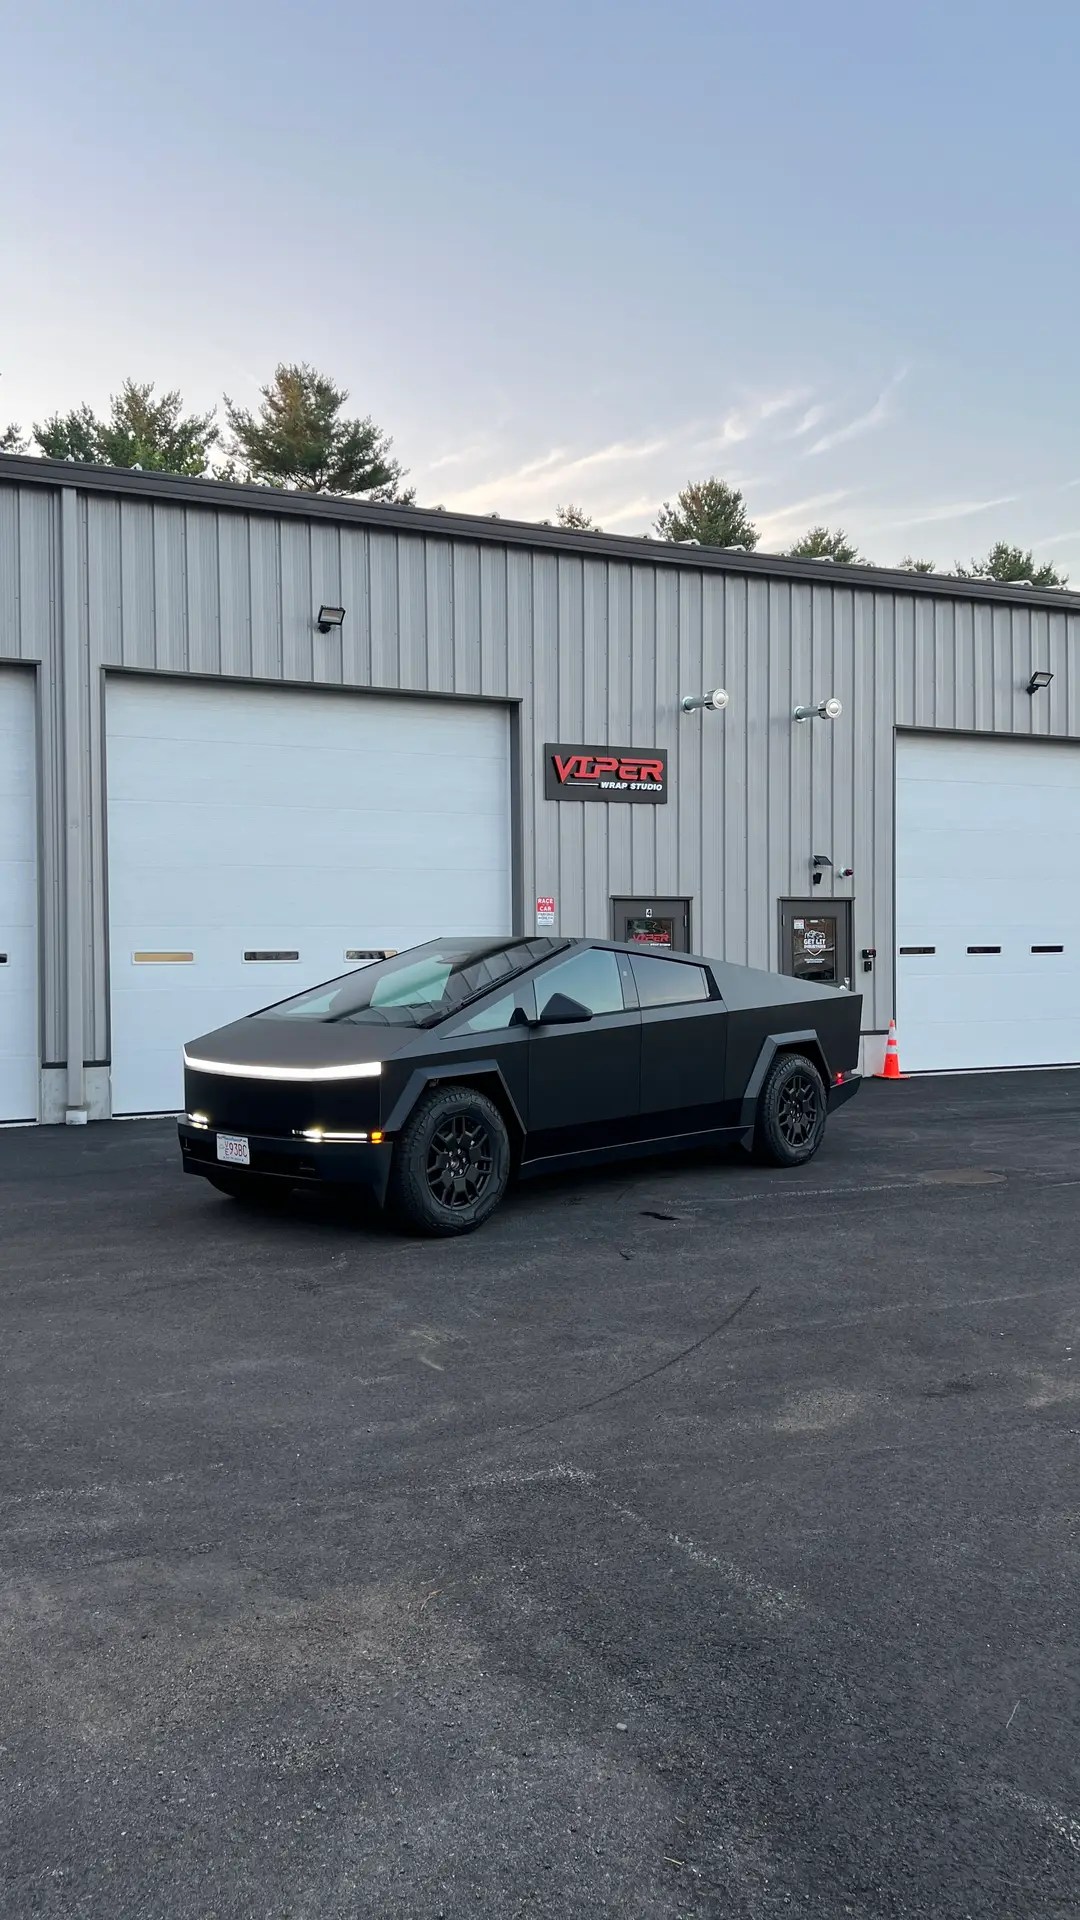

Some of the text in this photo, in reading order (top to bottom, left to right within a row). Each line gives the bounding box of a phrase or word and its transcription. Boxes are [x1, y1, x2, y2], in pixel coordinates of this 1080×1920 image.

[554, 755, 664, 783] VIPER
[601, 782, 663, 791] WRAP STUDIO
[646, 909, 651, 917] 4
[633, 934, 669, 943] VIPER
